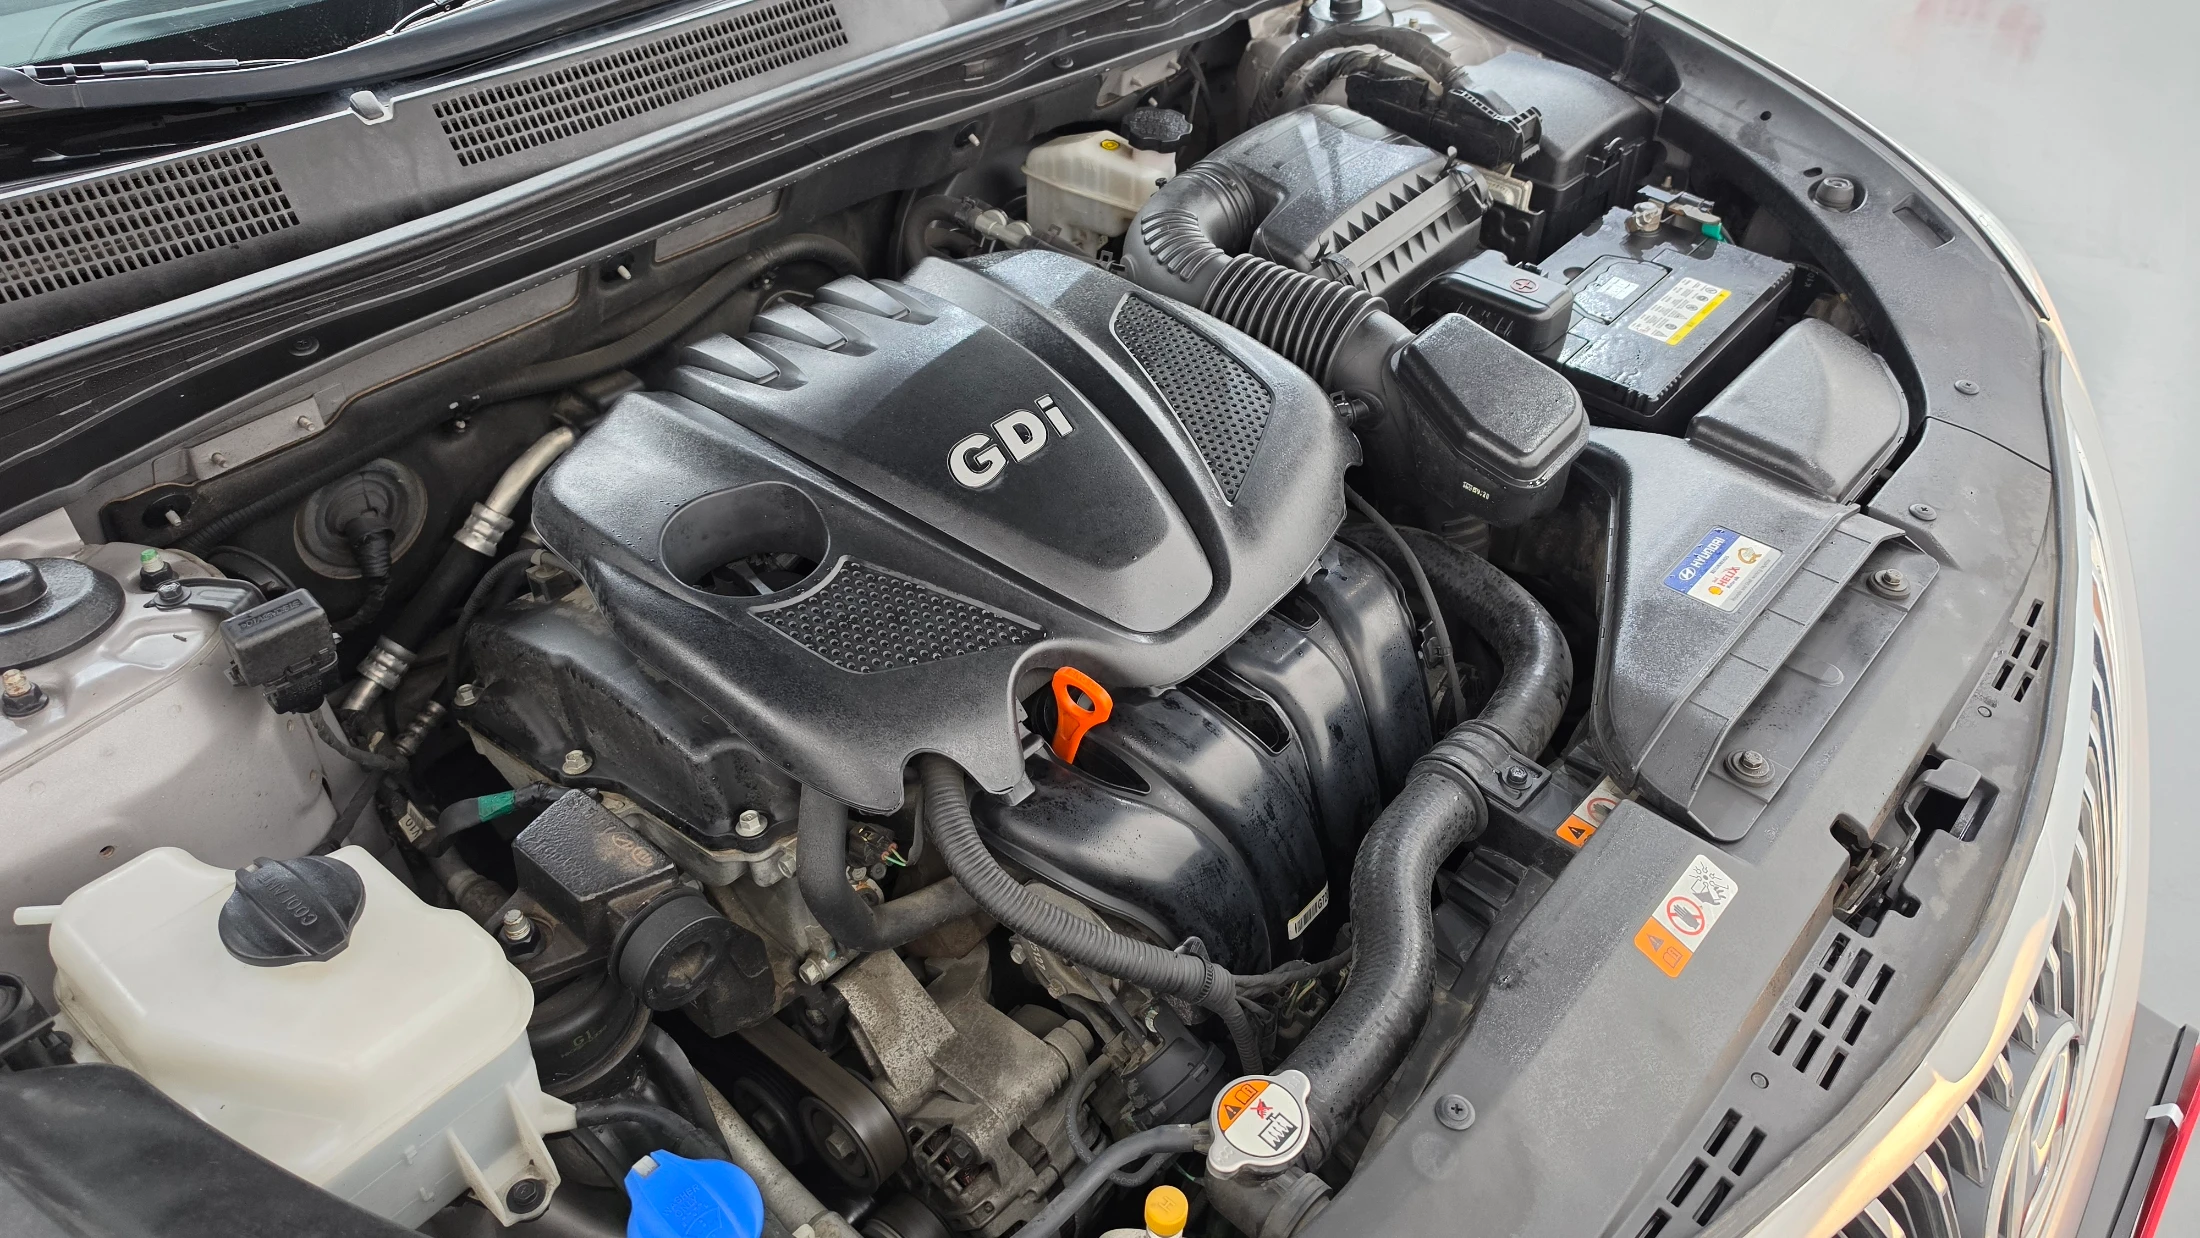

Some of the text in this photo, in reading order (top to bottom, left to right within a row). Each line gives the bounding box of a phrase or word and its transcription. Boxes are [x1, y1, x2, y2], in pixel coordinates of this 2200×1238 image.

[947, 394, 1075, 489] GDi
[1690, 536, 1725, 568] HYUNDAI
[1717, 566, 1740, 587] HELIX
[257, 873, 318, 926] COOLANT
[662, 1183, 701, 1217] WASHER
[674, 1195, 698, 1218] ONLY
